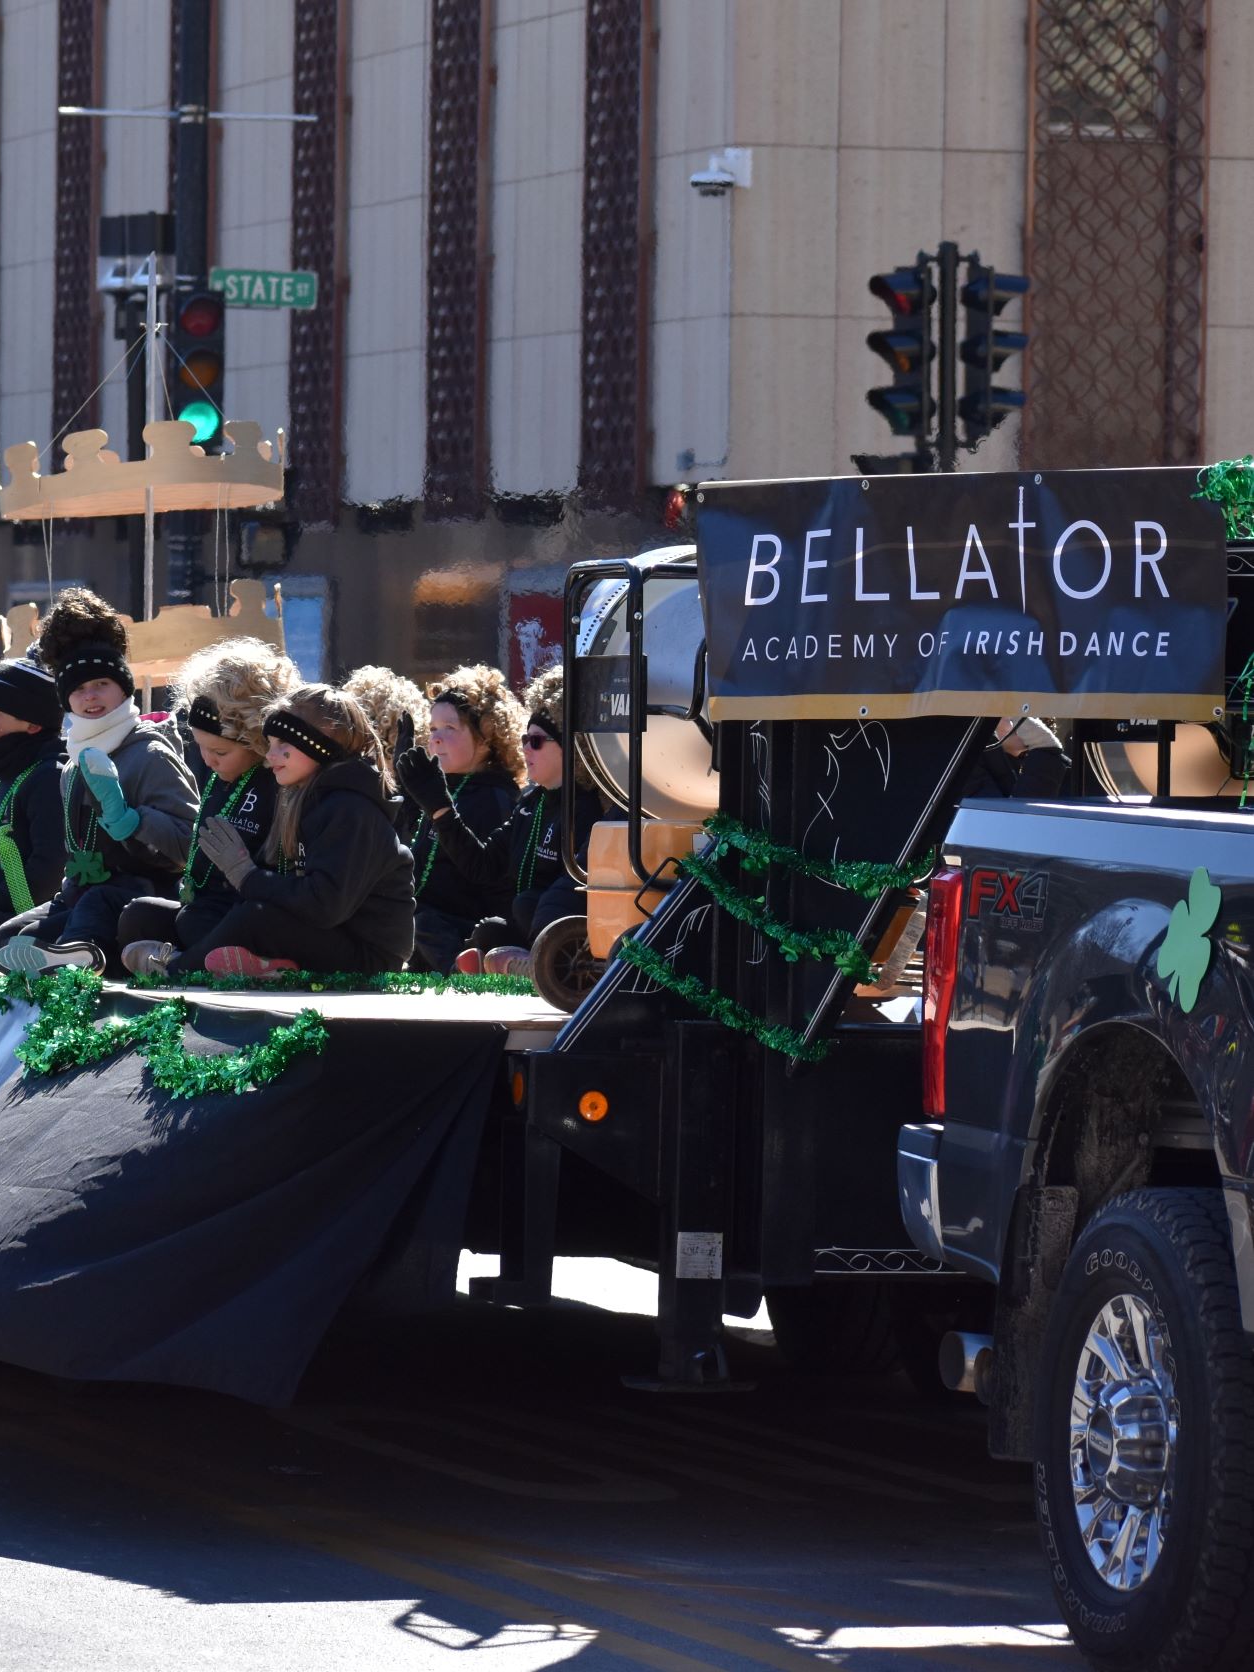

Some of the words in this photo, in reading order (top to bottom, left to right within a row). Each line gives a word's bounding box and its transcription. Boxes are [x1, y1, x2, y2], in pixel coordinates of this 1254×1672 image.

[225, 275, 294, 302] STATE
[296, 283, 310, 297] ST
[744, 485, 1170, 615] BELLATOR
[742, 633, 898, 663] ACADEMY
[918, 632, 949, 659] OF
[963, 630, 1044, 657] IRISH
[1059, 630, 1170, 659] DANCE
[965, 865, 1050, 922] FX4
